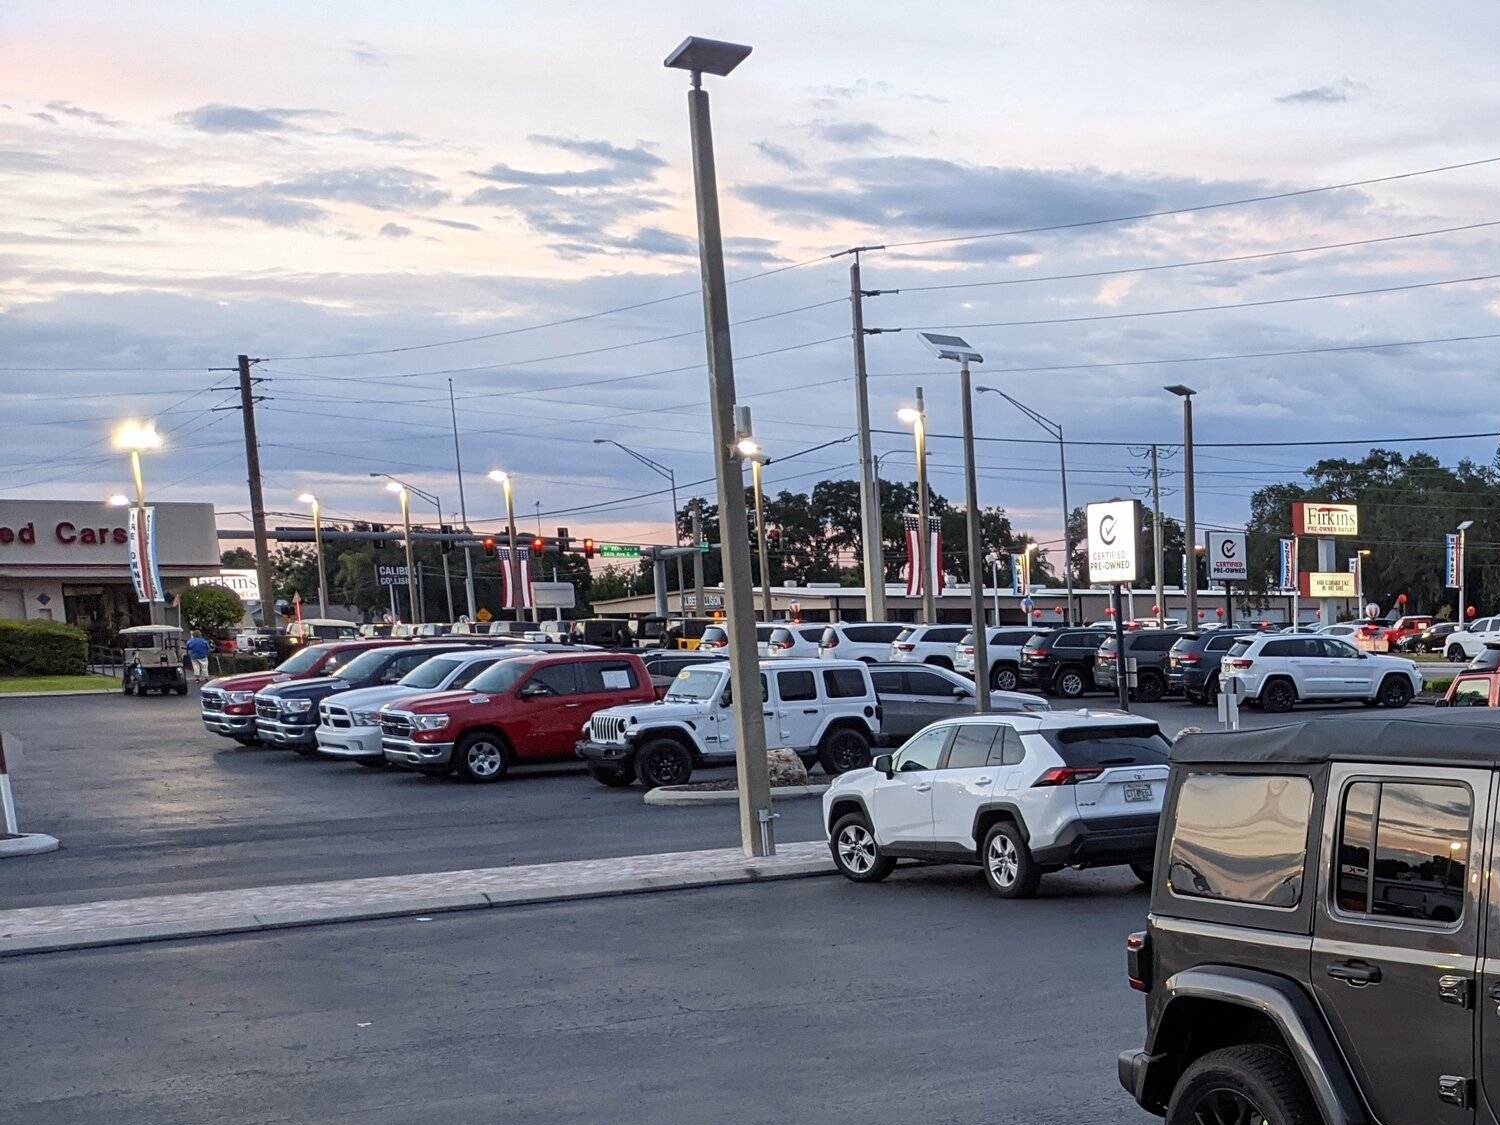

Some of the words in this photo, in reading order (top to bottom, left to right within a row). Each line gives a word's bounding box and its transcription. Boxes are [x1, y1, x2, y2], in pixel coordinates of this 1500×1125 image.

[1307, 507, 1356, 526] Firkins
[55, 521, 129, 545] Cars
[1092, 550, 1127, 561] CERTIFIED
[1090, 561, 1130, 571] PRE-OWNED
[1015, 558, 1023, 594] SALE
